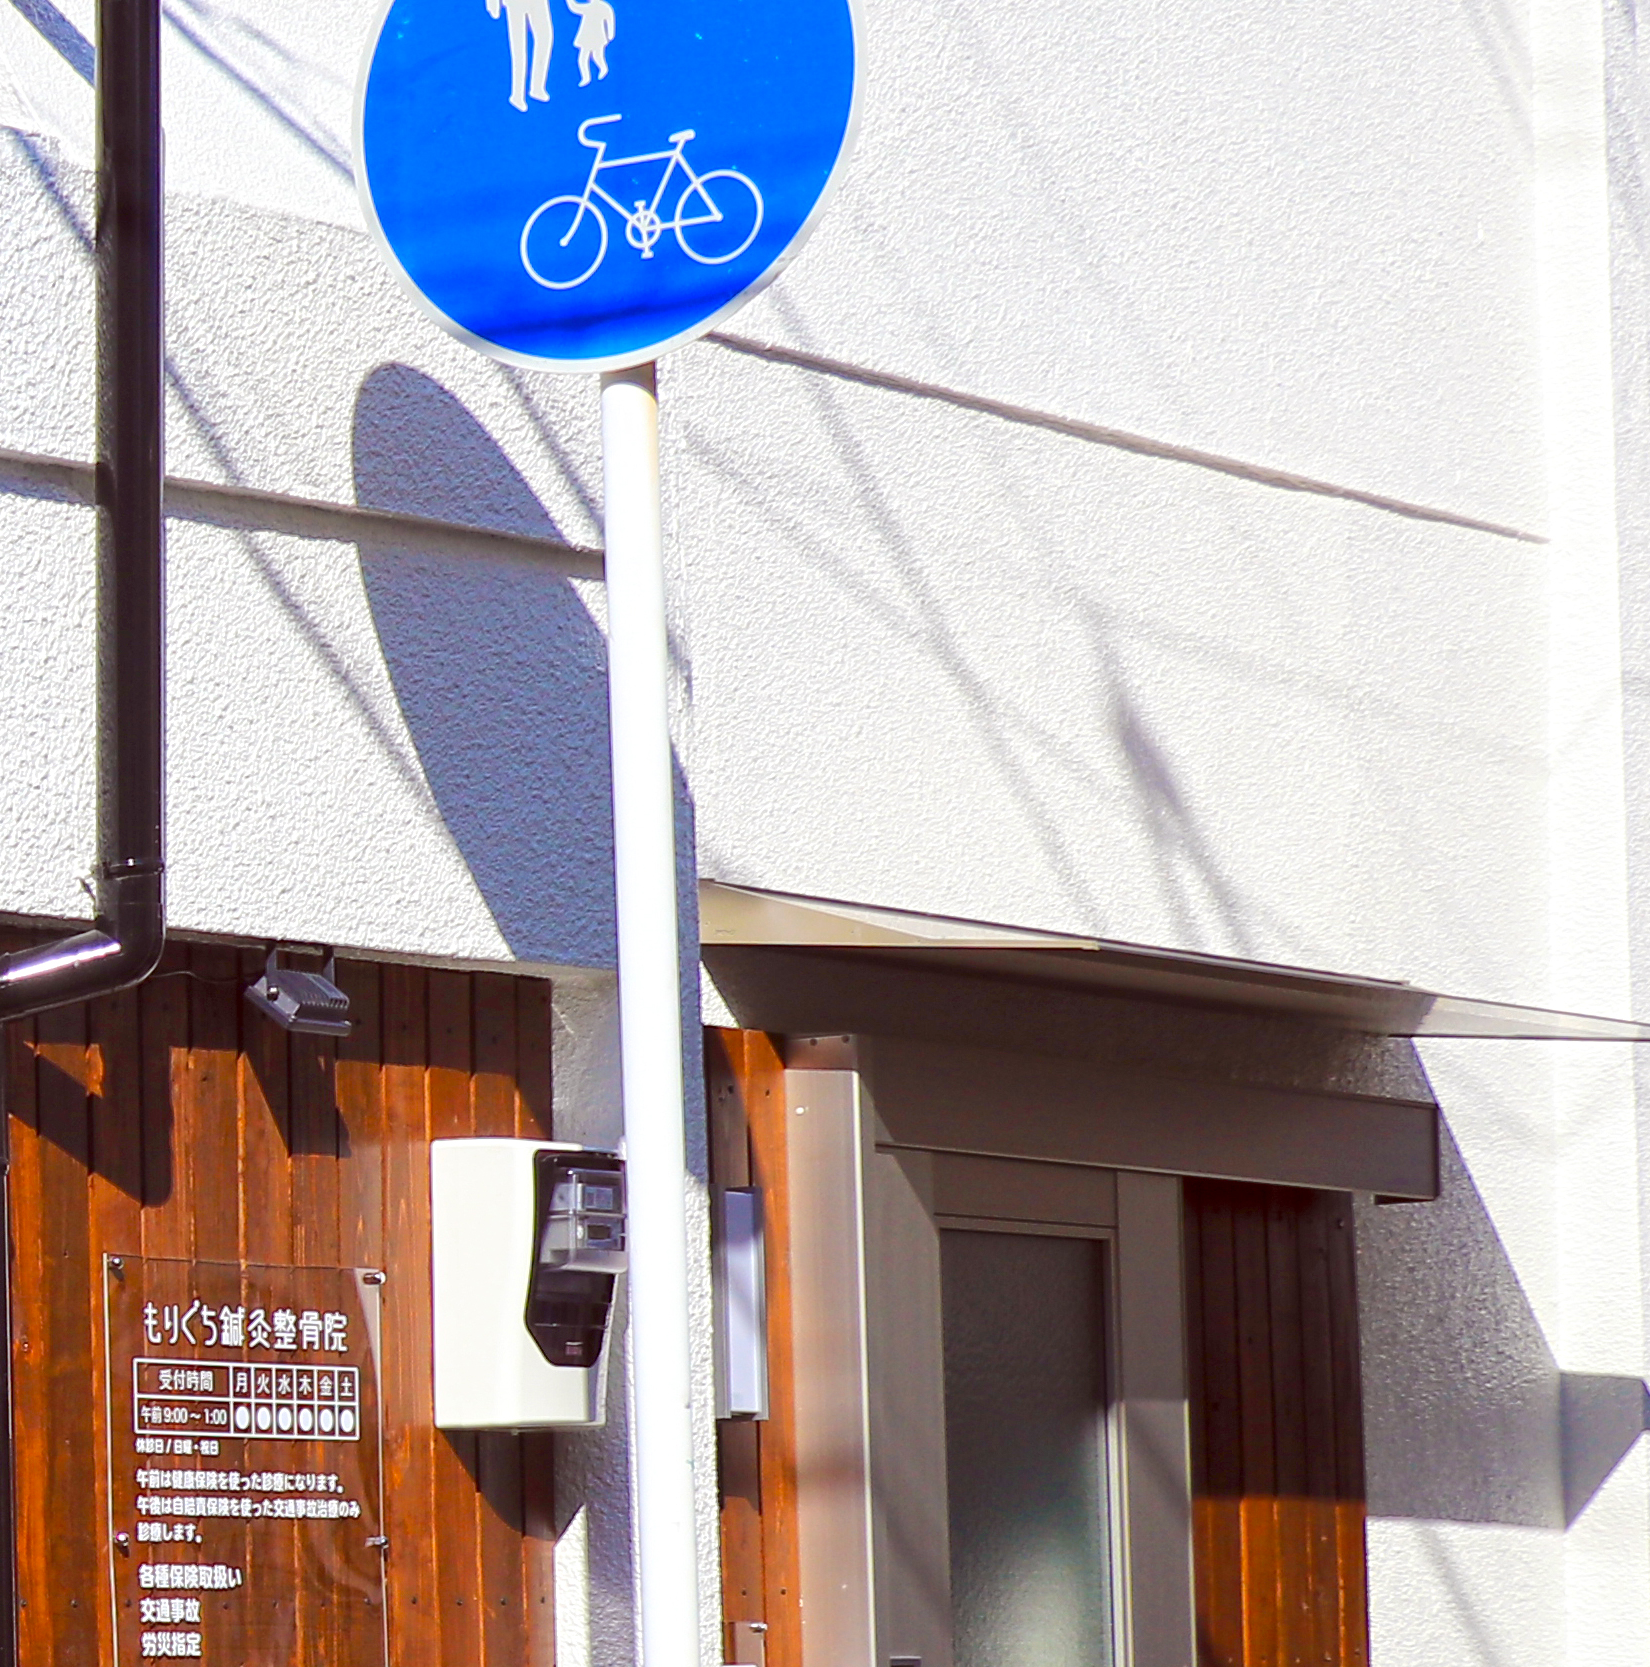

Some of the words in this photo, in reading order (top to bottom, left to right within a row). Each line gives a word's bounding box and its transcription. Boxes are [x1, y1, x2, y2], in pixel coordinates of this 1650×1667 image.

[143, 1299, 347, 1351] もりぐち鍼灸整骨院
[158, 1369, 214, 1392] 受付時間
[235, 1372, 247, 1392] 月
[257, 1373, 270, 1393] 火
[278, 1374, 291, 1394] 水
[299, 1375, 312, 1395] 木
[319, 1375, 332, 1396] 金
[340, 1376, 353, 1397] 土
[136, 1469, 344, 1494] 午前は健康保険を使った診療になります。
[137, 1522, 203, 1543] 診療します。
[139, 1564, 242, 1589] 各種保険取扱い
[140, 1598, 201, 1623] 交通事故
[141, 1631, 202, 1657] 労災指定
